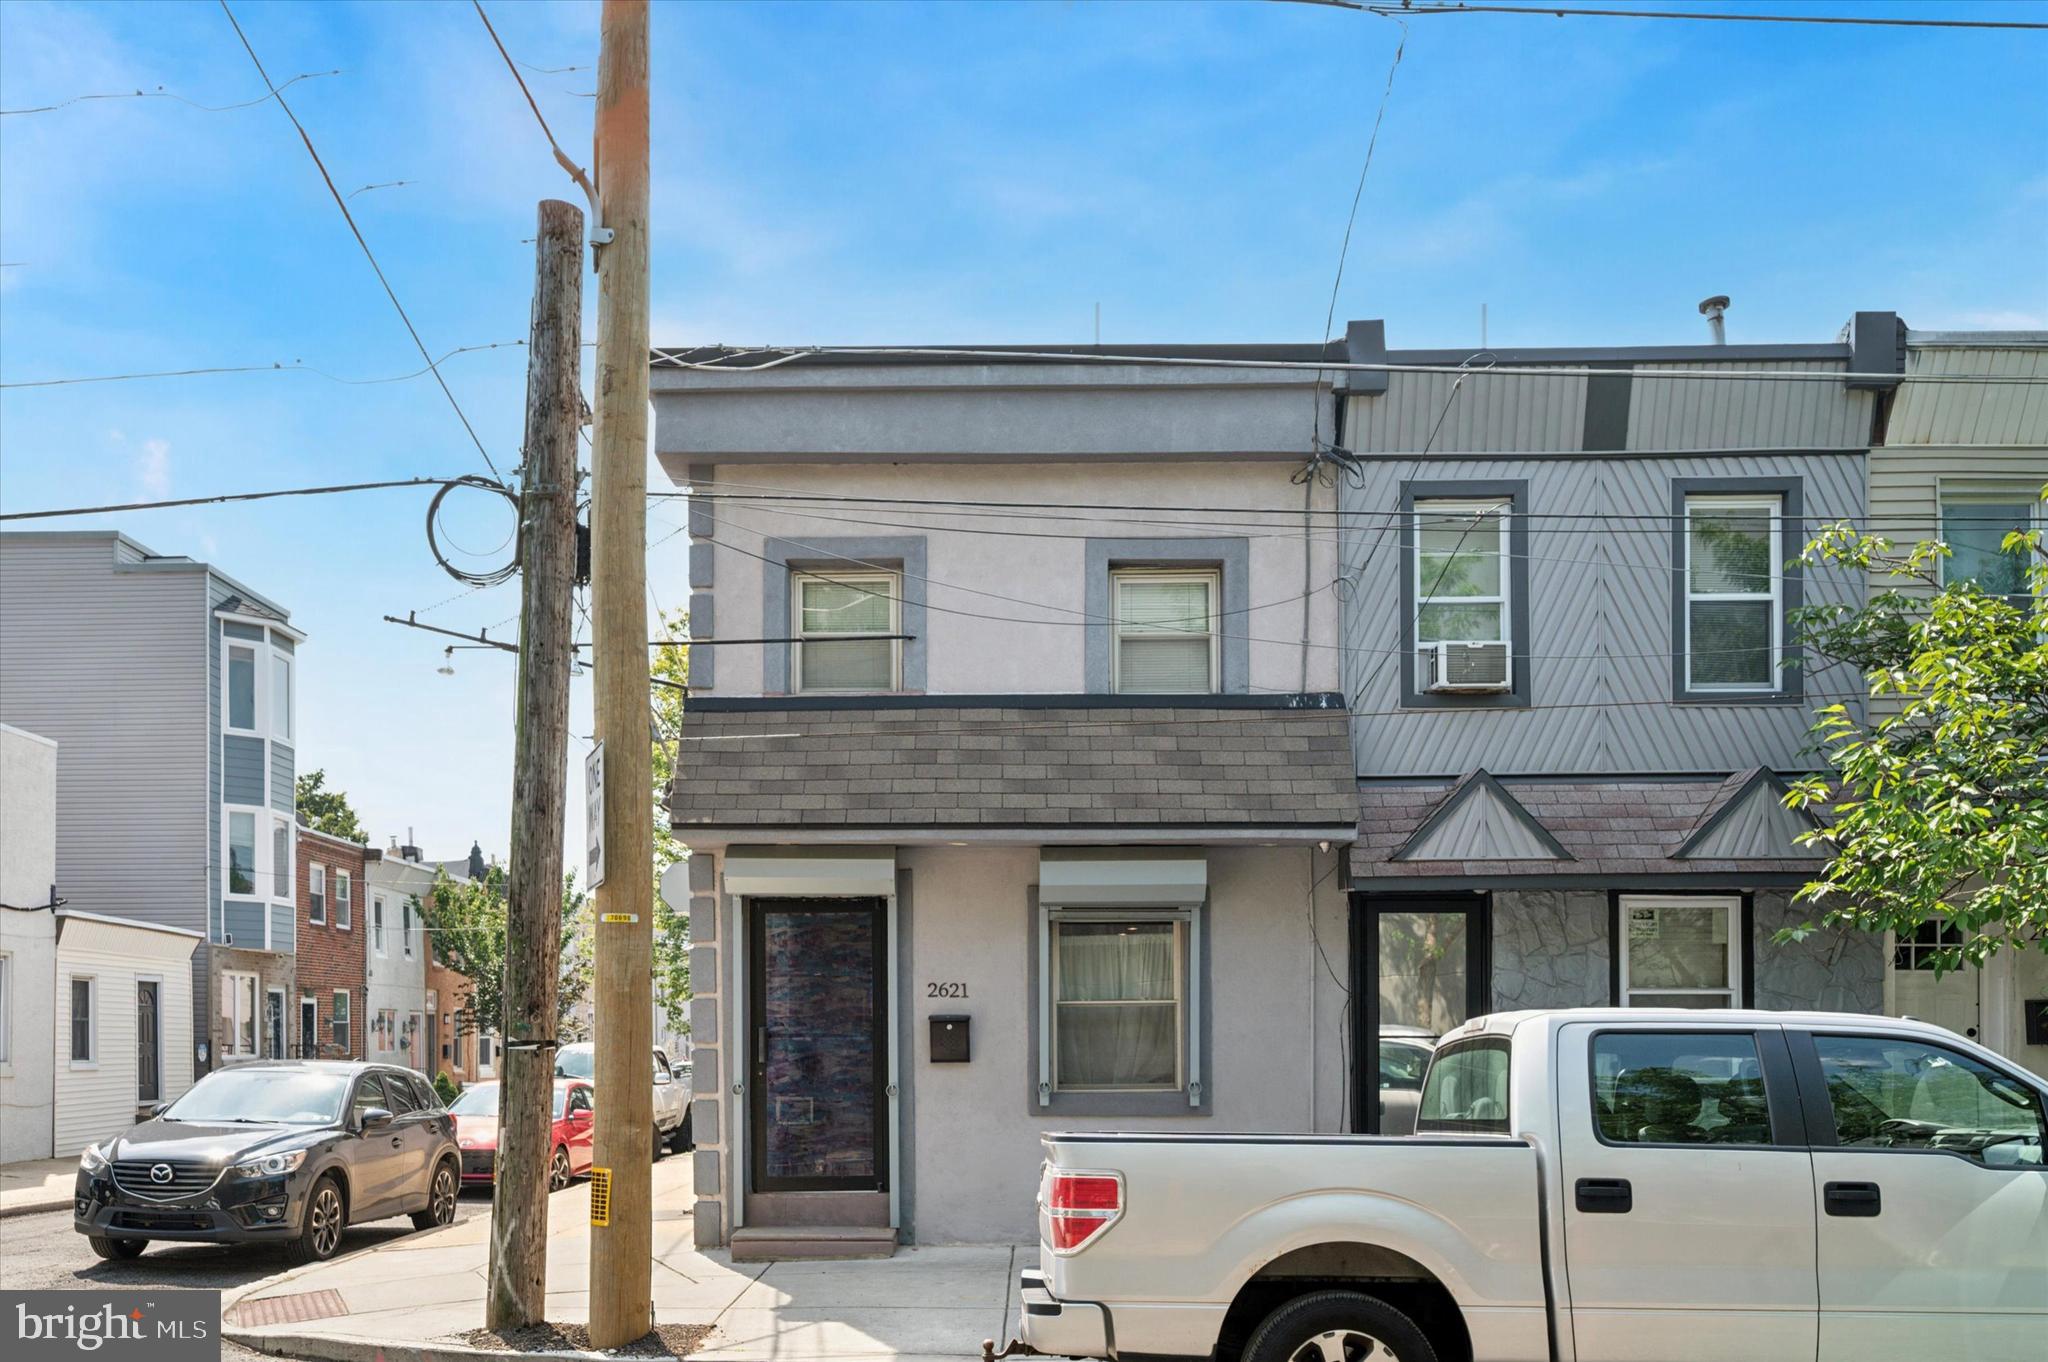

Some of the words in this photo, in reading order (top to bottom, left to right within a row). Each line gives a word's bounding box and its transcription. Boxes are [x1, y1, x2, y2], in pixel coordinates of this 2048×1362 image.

[588, 758, 601, 795] ONE
[588, 796, 602, 833] WAY
[927, 982, 969, 998] 2621
